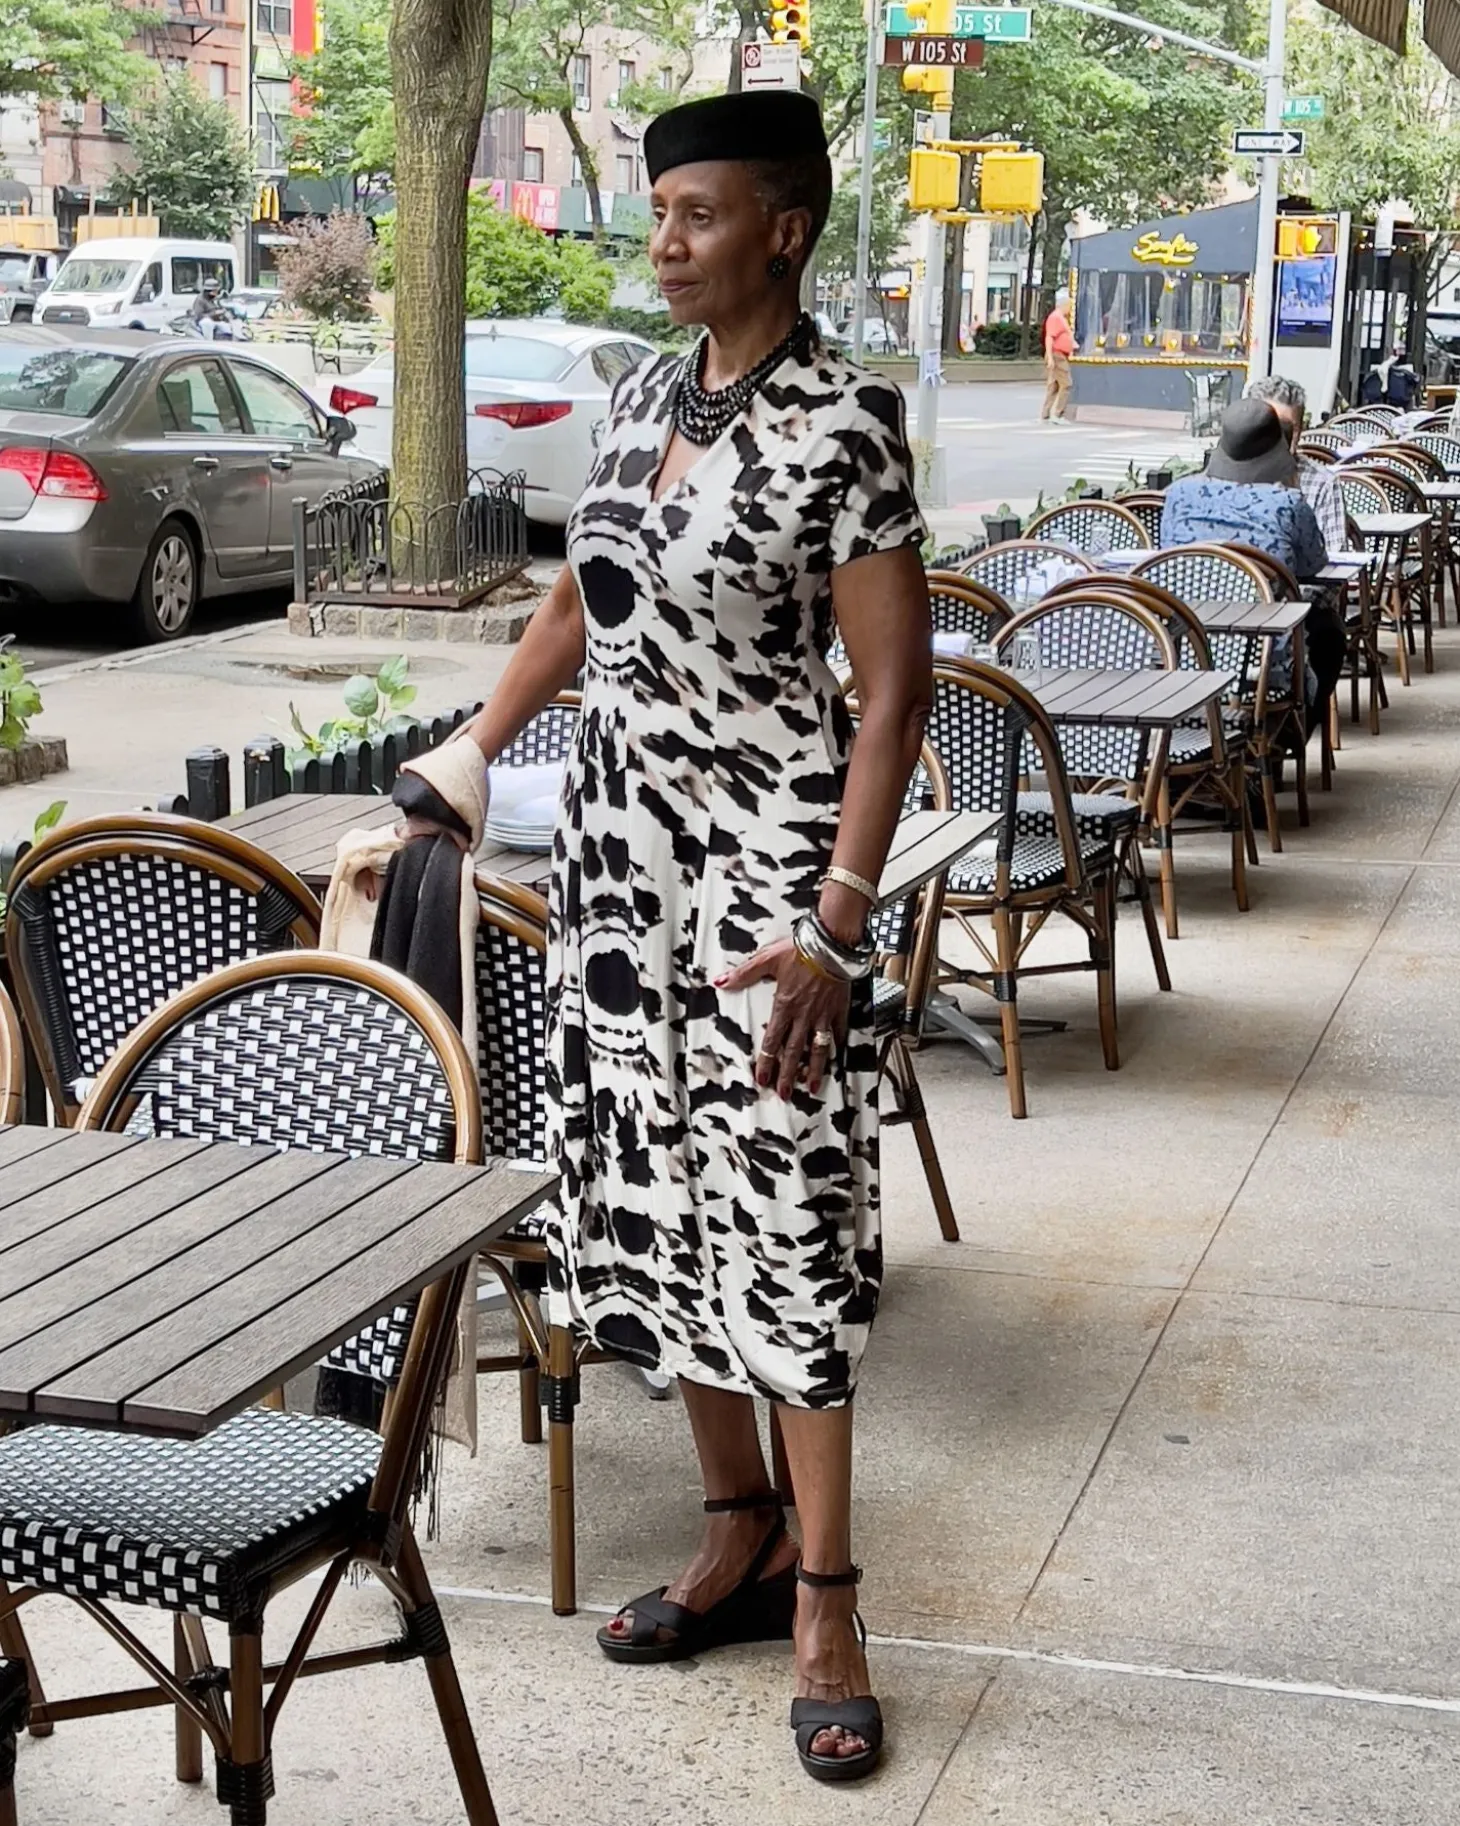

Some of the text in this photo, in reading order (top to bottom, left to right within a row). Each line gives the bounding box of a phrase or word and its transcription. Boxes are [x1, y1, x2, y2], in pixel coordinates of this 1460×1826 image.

[983, 14, 1002, 33] St
[902, 41, 967, 63] W 105 St
[1295, 99, 1312, 115] 105
